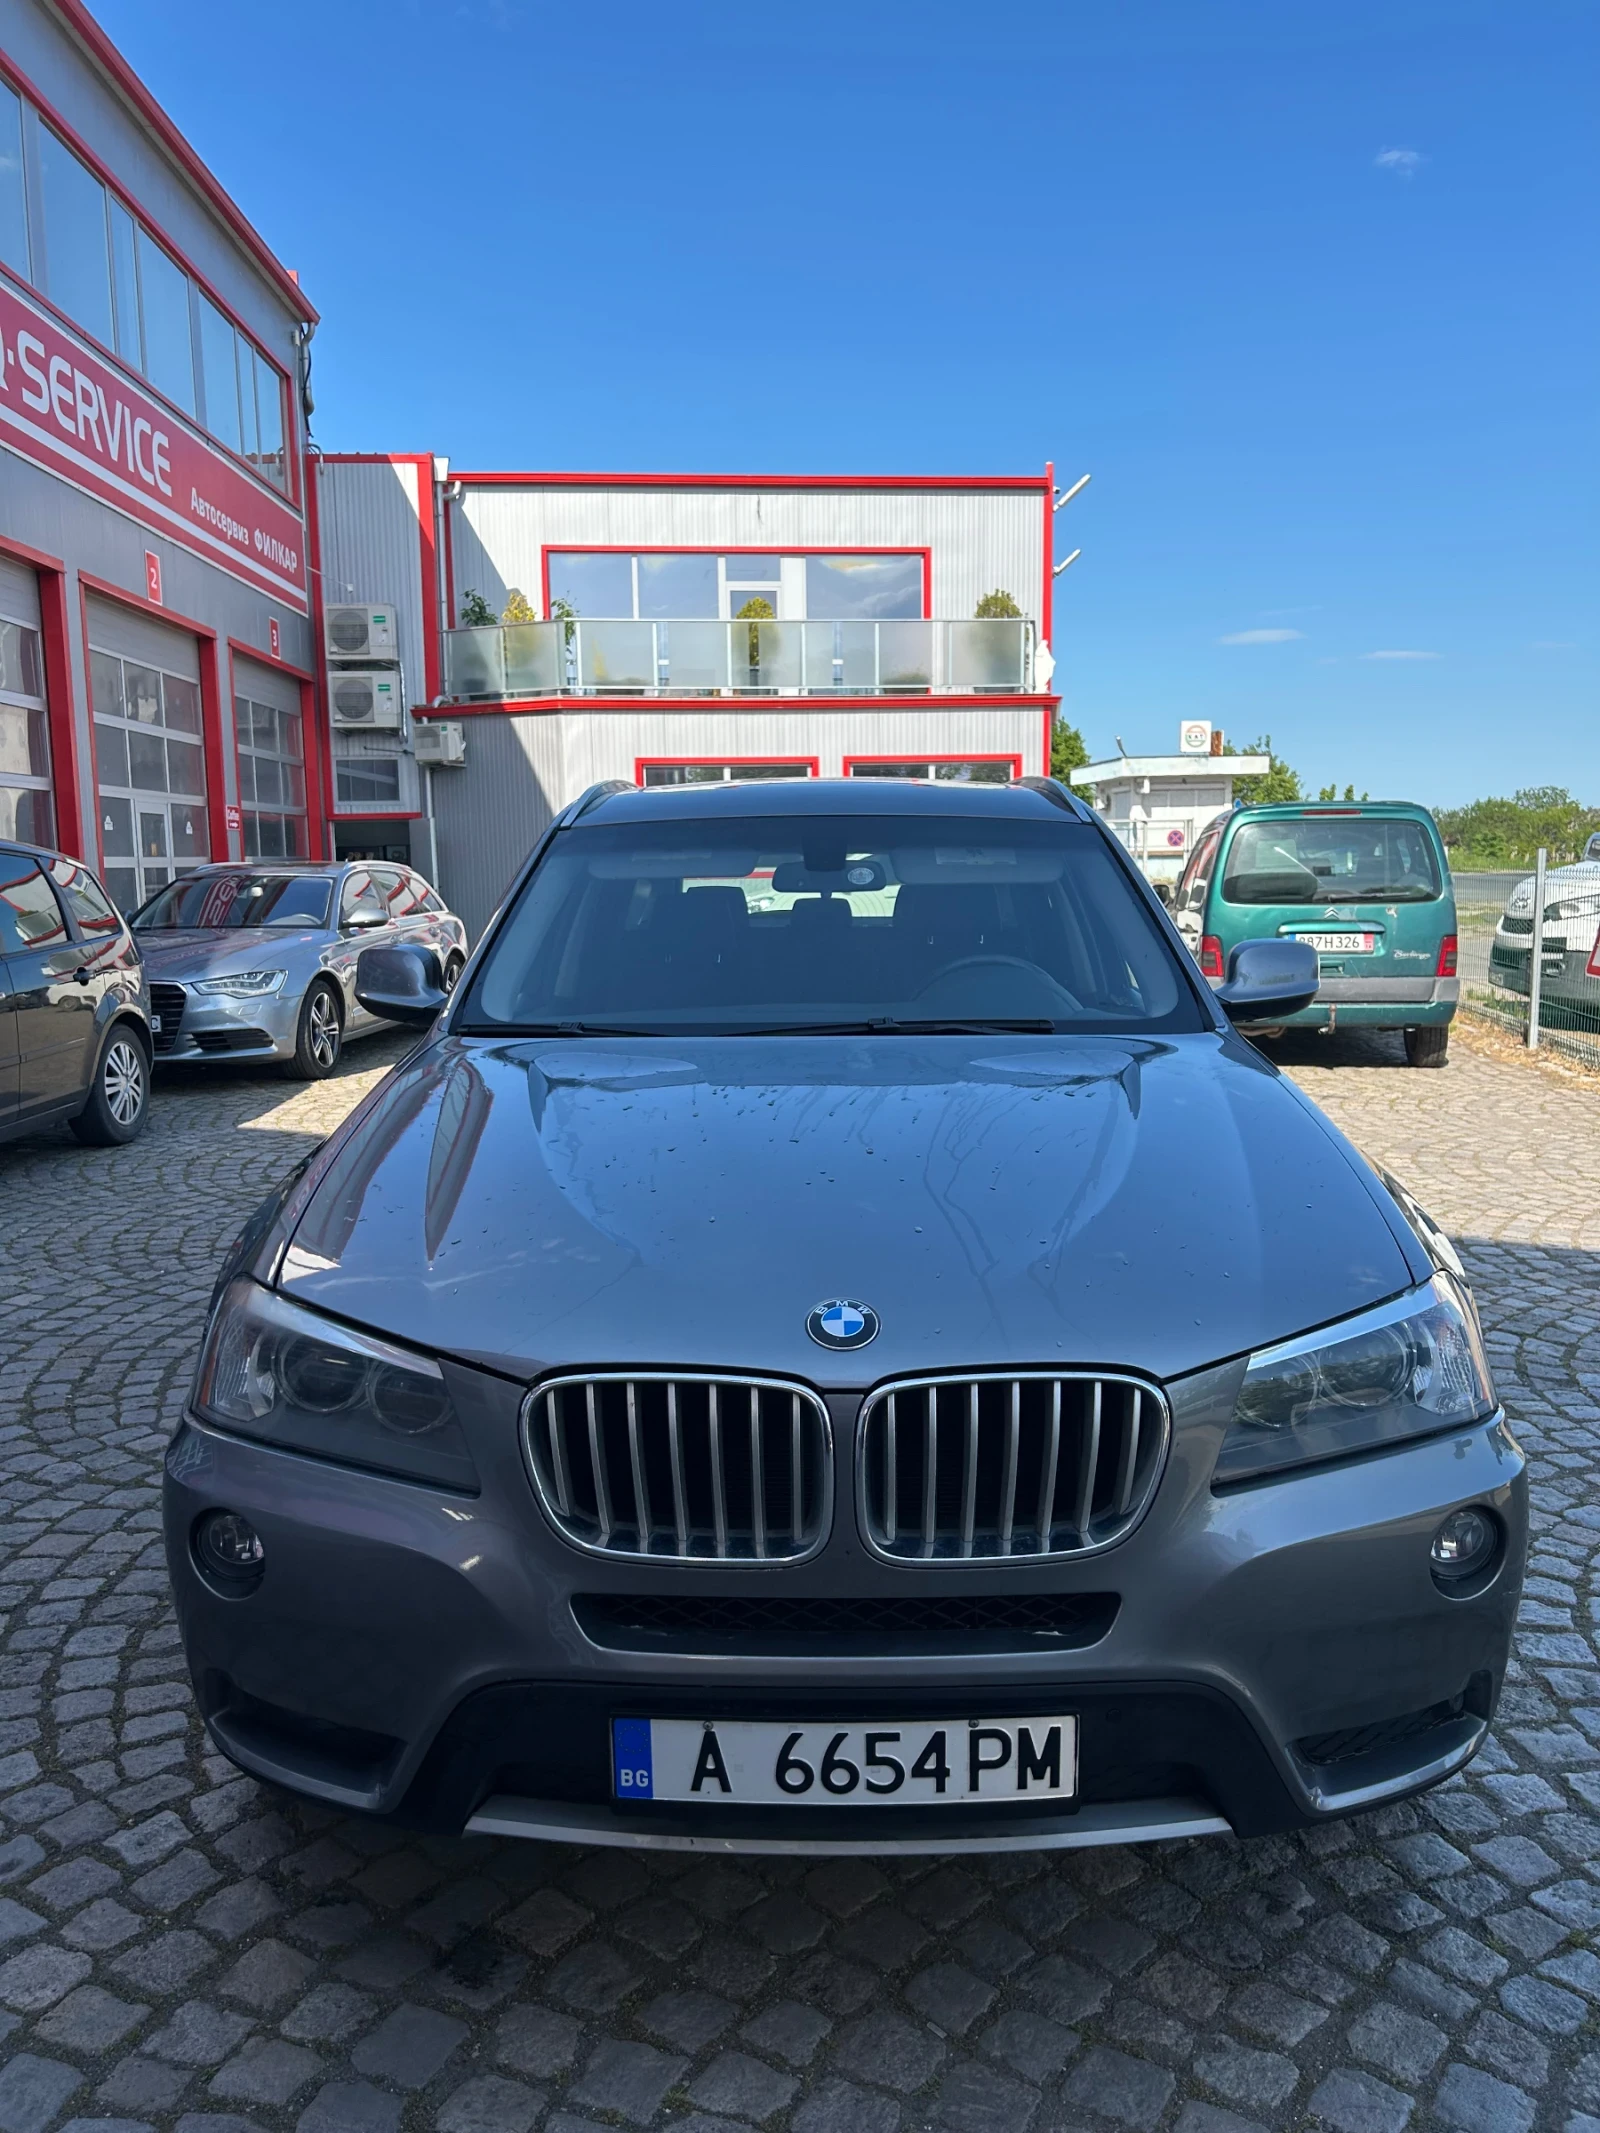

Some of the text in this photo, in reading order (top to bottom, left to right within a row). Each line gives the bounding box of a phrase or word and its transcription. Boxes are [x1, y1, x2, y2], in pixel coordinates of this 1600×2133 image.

[191, 486, 298, 573] Автосервиз ФИЛКАР
[150, 567, 158, 589] 2
[272, 629, 278, 647] 3
[814, 1300, 872, 1315] BMW
[690, 1730, 732, 1793] A
[620, 1769, 649, 1787] BG
